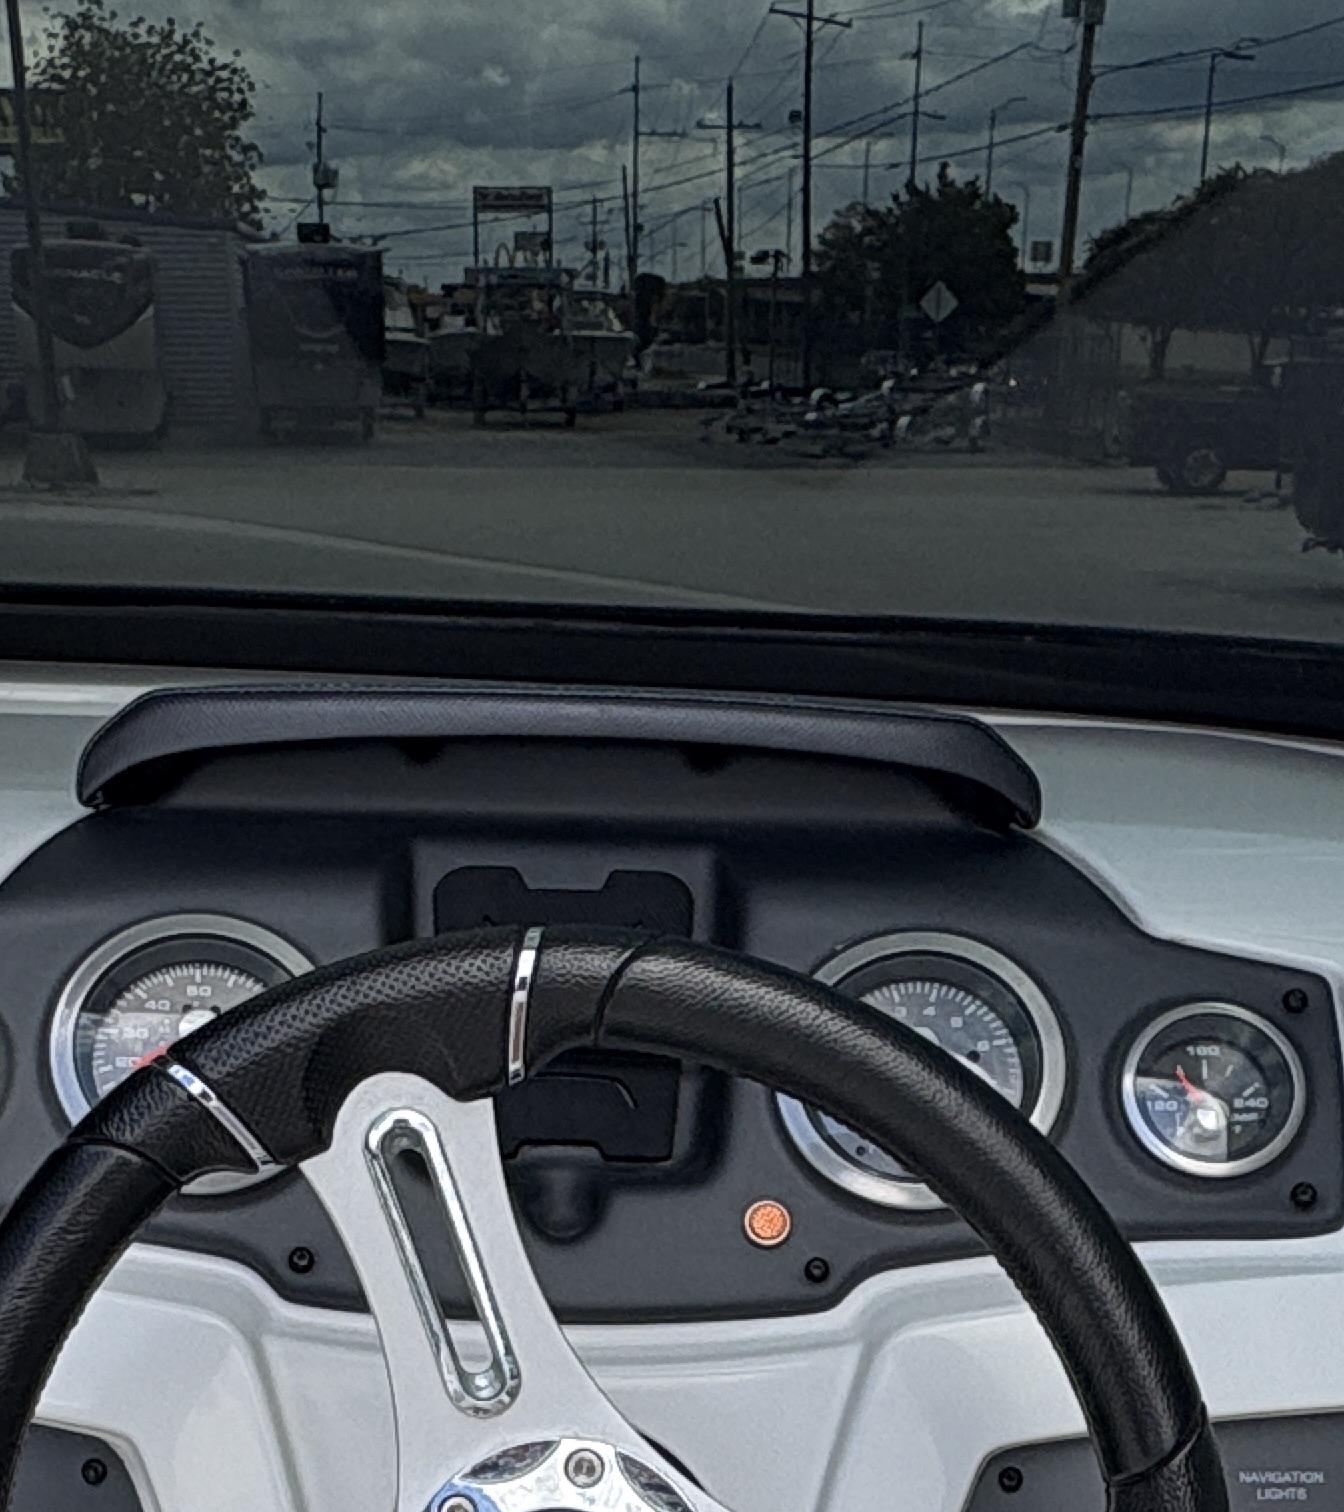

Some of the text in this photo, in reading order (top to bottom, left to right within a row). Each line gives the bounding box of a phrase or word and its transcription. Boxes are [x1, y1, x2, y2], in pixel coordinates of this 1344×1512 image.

[144, 1000, 170, 1010] 40
[1238, 1470, 1325, 1484] NAVIGATION
[1256, 1487, 1307, 1501] LIGHTS
